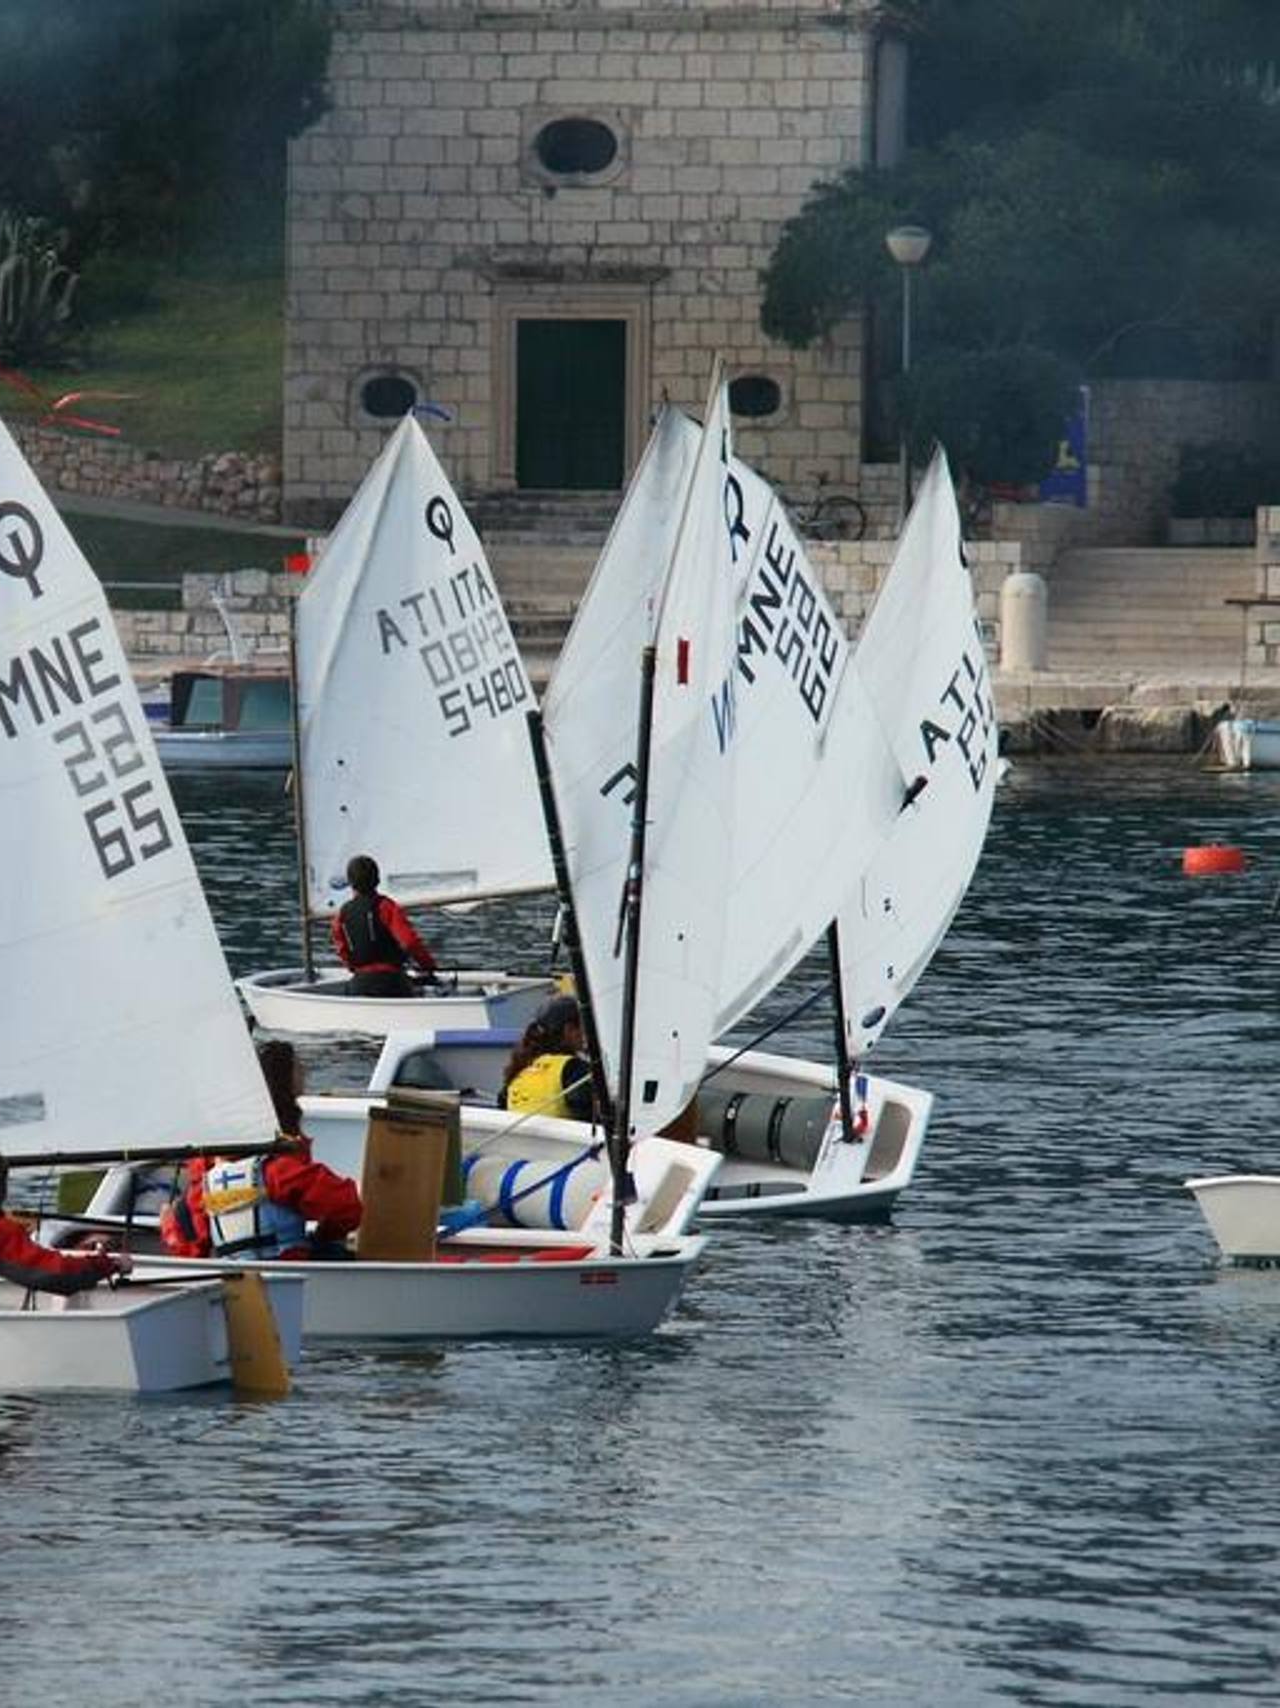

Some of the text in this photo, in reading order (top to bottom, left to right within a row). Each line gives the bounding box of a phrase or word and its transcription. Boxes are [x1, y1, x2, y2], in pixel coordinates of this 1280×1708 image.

[449, 562, 494, 619] ITA
[736, 521, 796, 686] MNE
[438, 657, 527, 737] 5480
[799, 609, 839, 723] 62
[83, 779, 174, 880] 65
